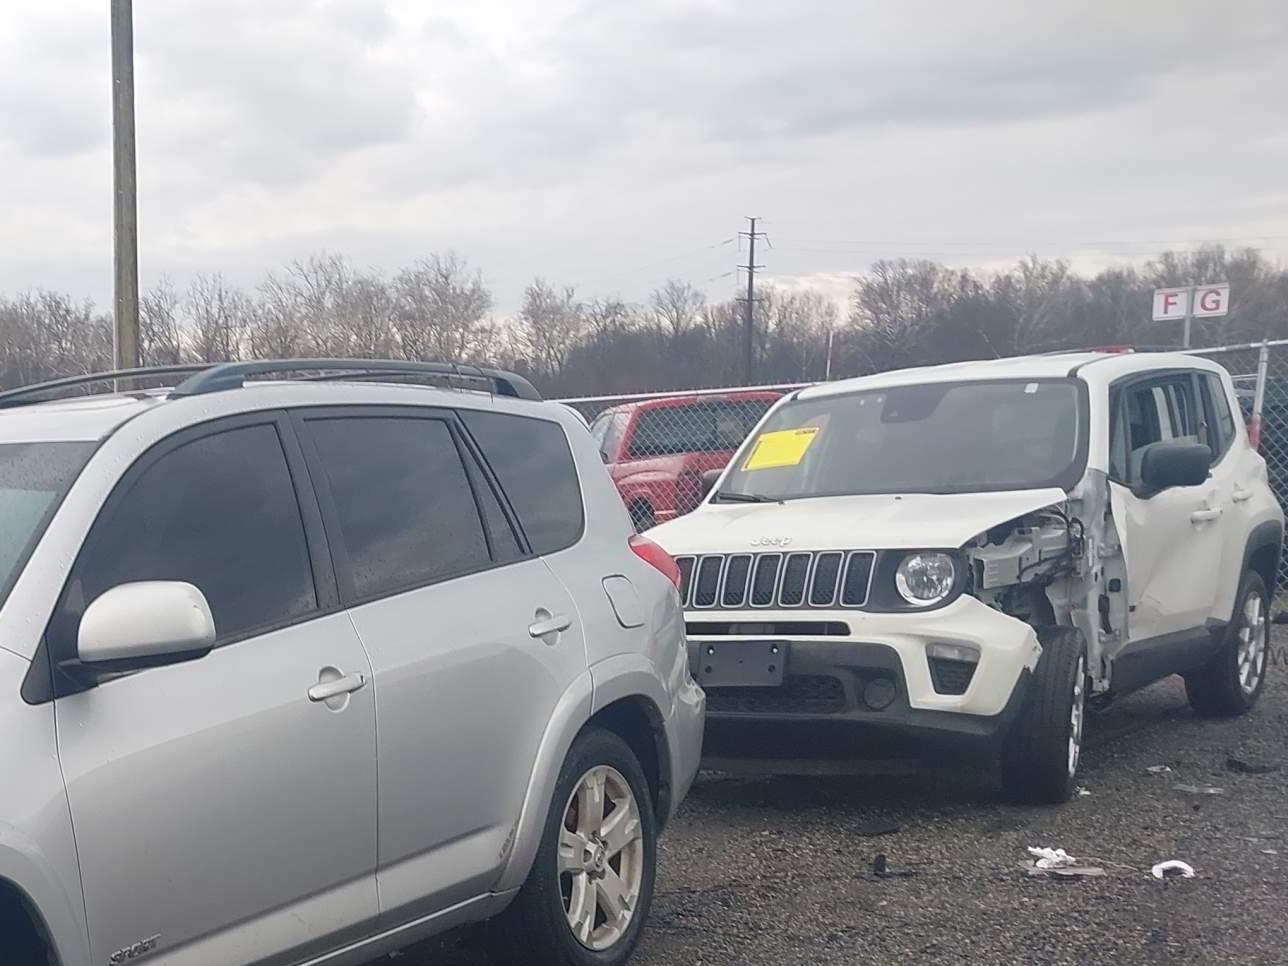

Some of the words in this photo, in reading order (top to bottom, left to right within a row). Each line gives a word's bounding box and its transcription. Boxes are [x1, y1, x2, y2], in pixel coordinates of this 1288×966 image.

[1163, 293, 1178, 315] F
[1200, 289, 1221, 312] G
[750, 534, 793, 548] Jeep
